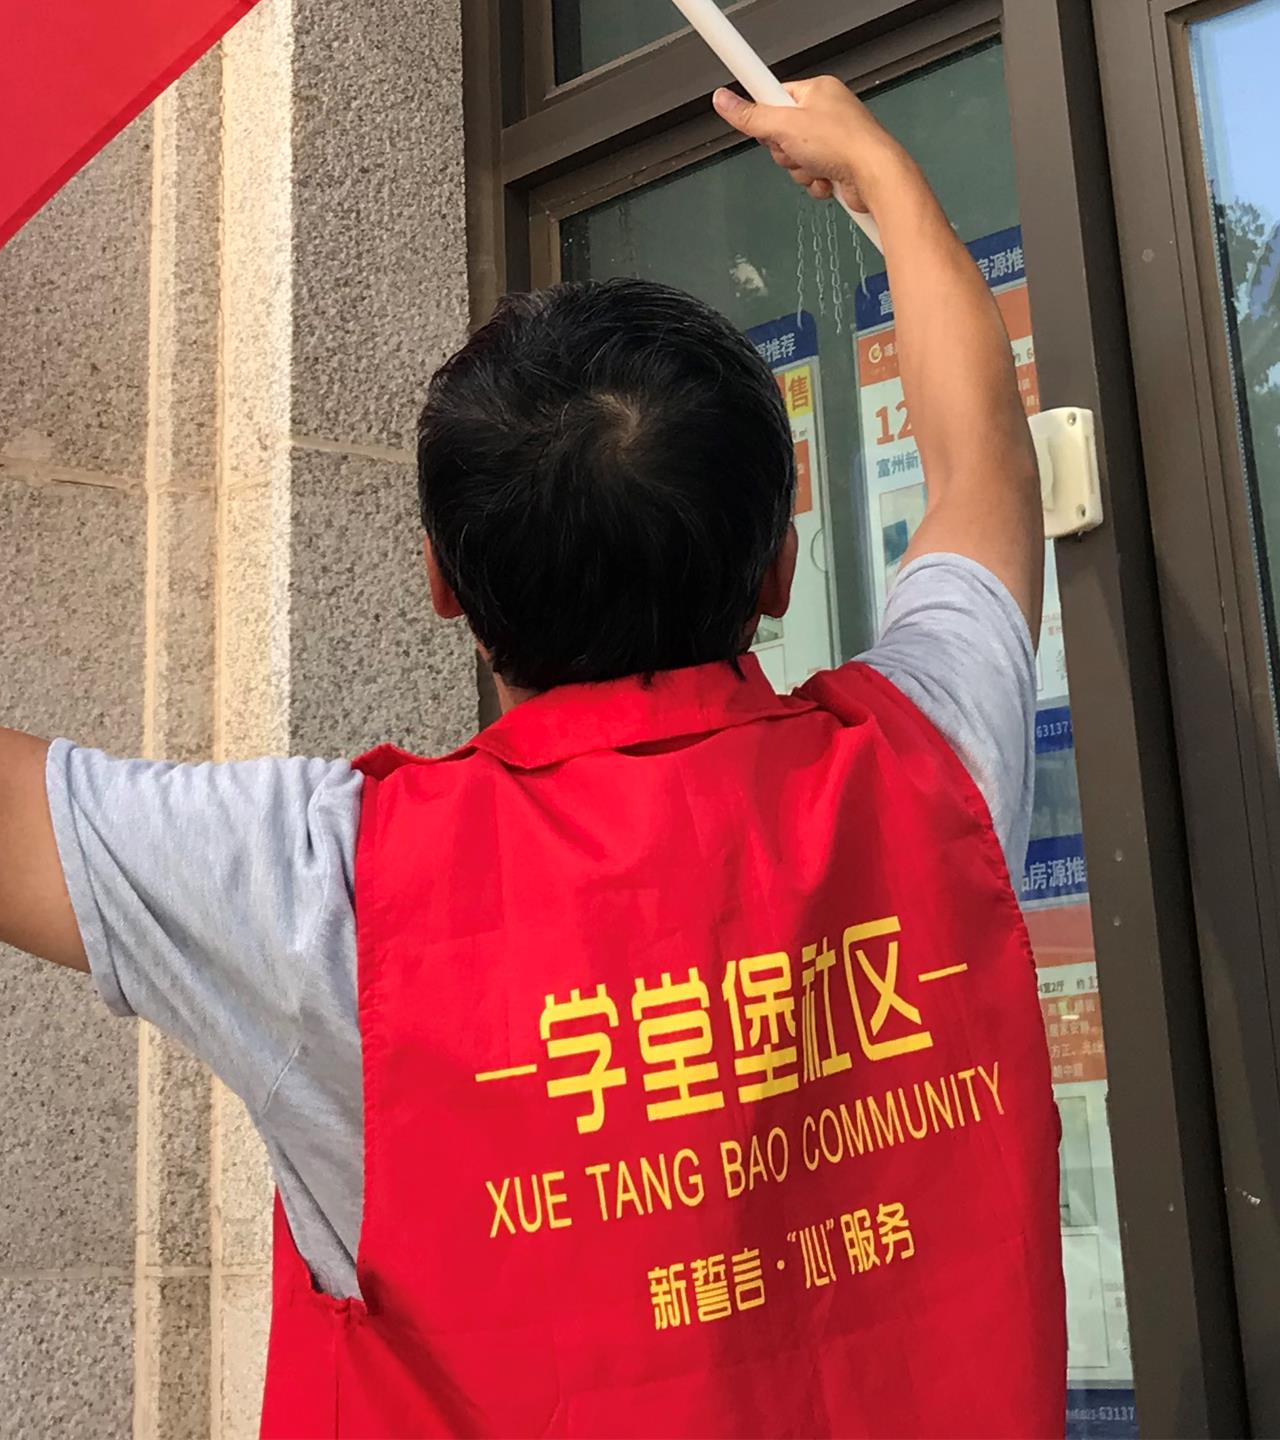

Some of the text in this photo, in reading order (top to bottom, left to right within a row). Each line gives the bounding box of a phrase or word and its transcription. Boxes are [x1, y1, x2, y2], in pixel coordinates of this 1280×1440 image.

[788, 375, 809, 411] 售
[1036, 720, 1072, 739] 63137
[485, 1062, 1005, 1239] XUE TANG BAO COMMUNITY
